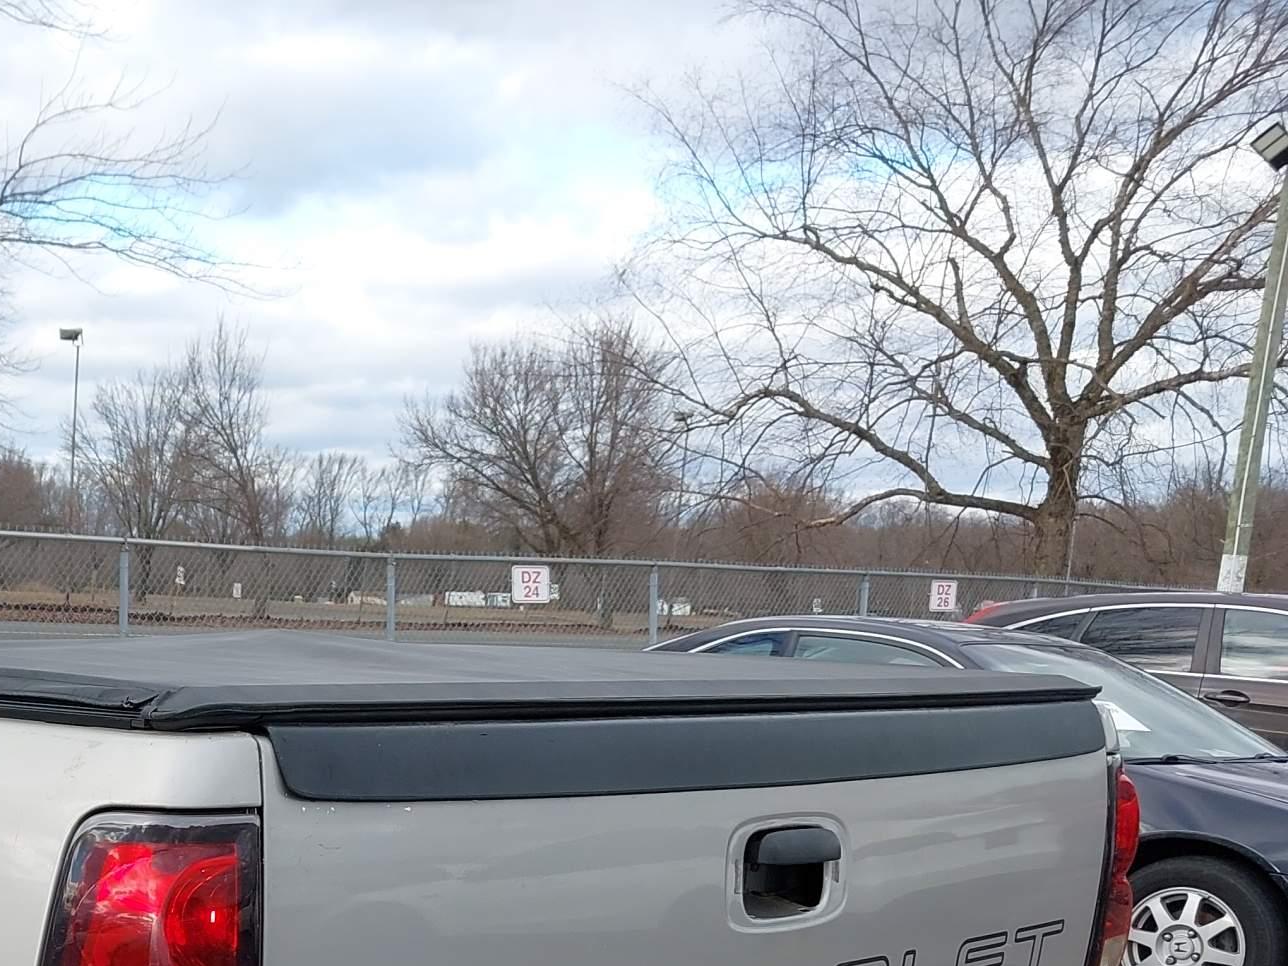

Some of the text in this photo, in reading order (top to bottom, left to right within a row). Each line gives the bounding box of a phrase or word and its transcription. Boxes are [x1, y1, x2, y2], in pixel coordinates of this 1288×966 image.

[521, 570, 541, 584] DZ
[523, 585, 539, 598] 24
[937, 584, 952, 595] DZ
[937, 596, 950, 607] 26
